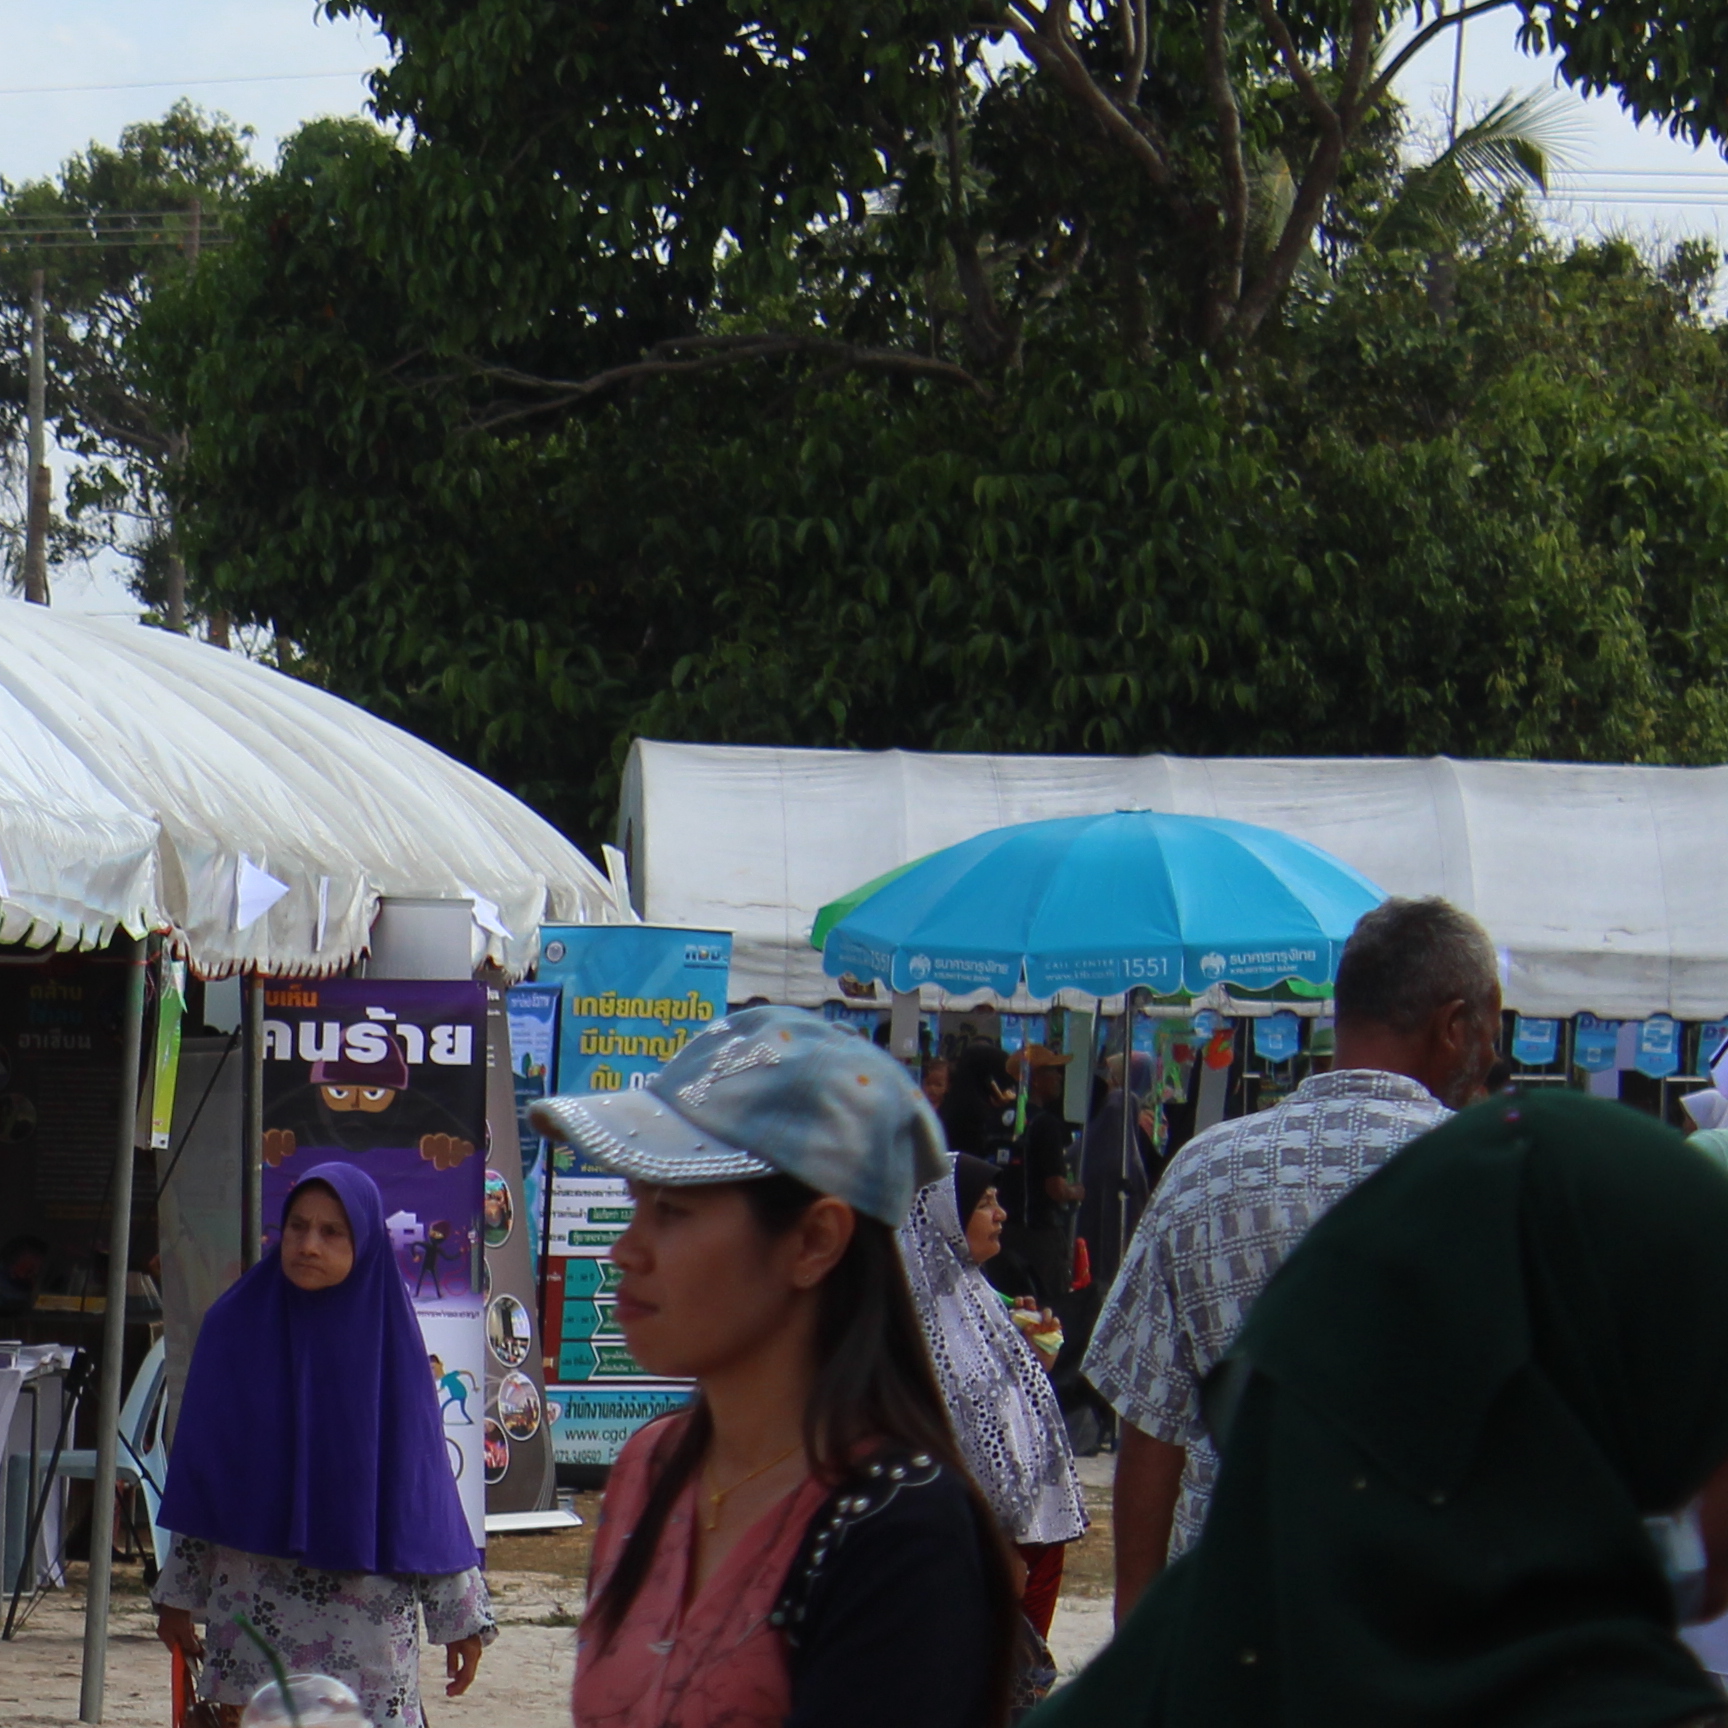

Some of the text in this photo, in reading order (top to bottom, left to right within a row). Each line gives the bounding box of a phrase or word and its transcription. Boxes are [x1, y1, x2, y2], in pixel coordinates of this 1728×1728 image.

[1123, 957, 1168, 977] 1551
[1229, 946, 1317, 965] ธนาคารกรุงไทย
[572, 990, 714, 1027] เกษียณสุขใจ
[263, 1007, 472, 1065] คนร้าย
[590, 1063, 622, 1091] กับ
